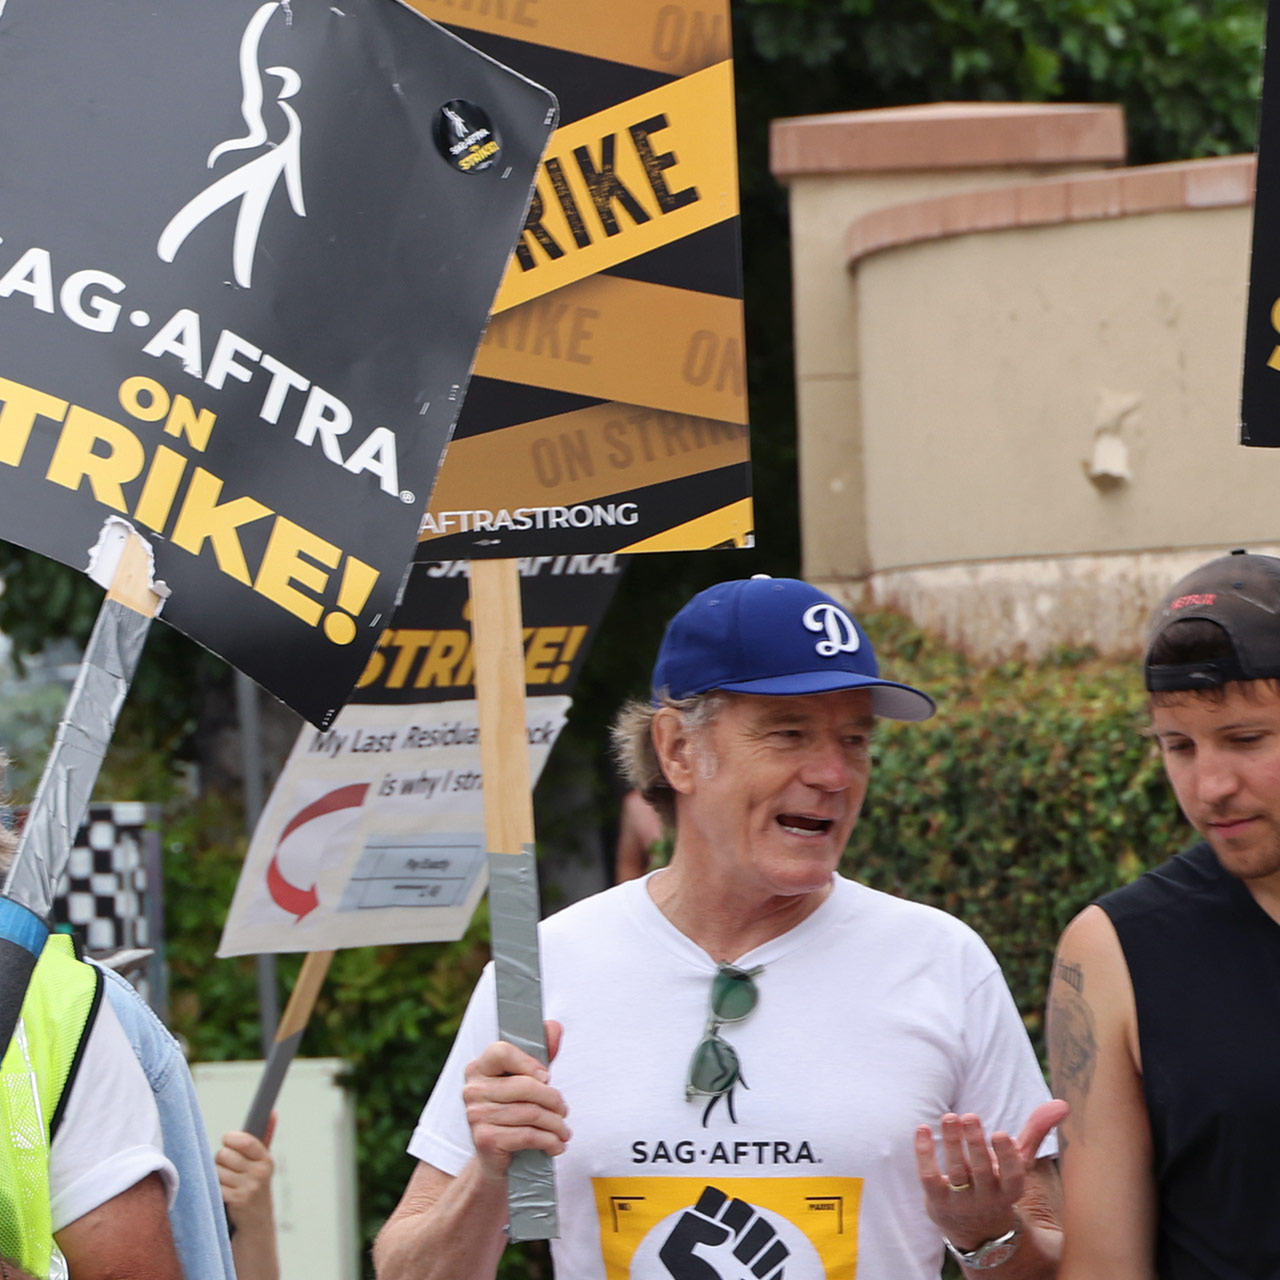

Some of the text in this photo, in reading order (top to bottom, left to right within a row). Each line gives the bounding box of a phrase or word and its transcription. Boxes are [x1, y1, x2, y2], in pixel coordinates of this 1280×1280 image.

[118, 375, 217, 452] ON
[530, 429, 596, 489] ON
[802, 603, 861, 657] D
[349, 729, 397, 753] Last
[402, 722, 480, 750] Residua
[378, 773, 397, 797] is
[401, 770, 439, 800] why
